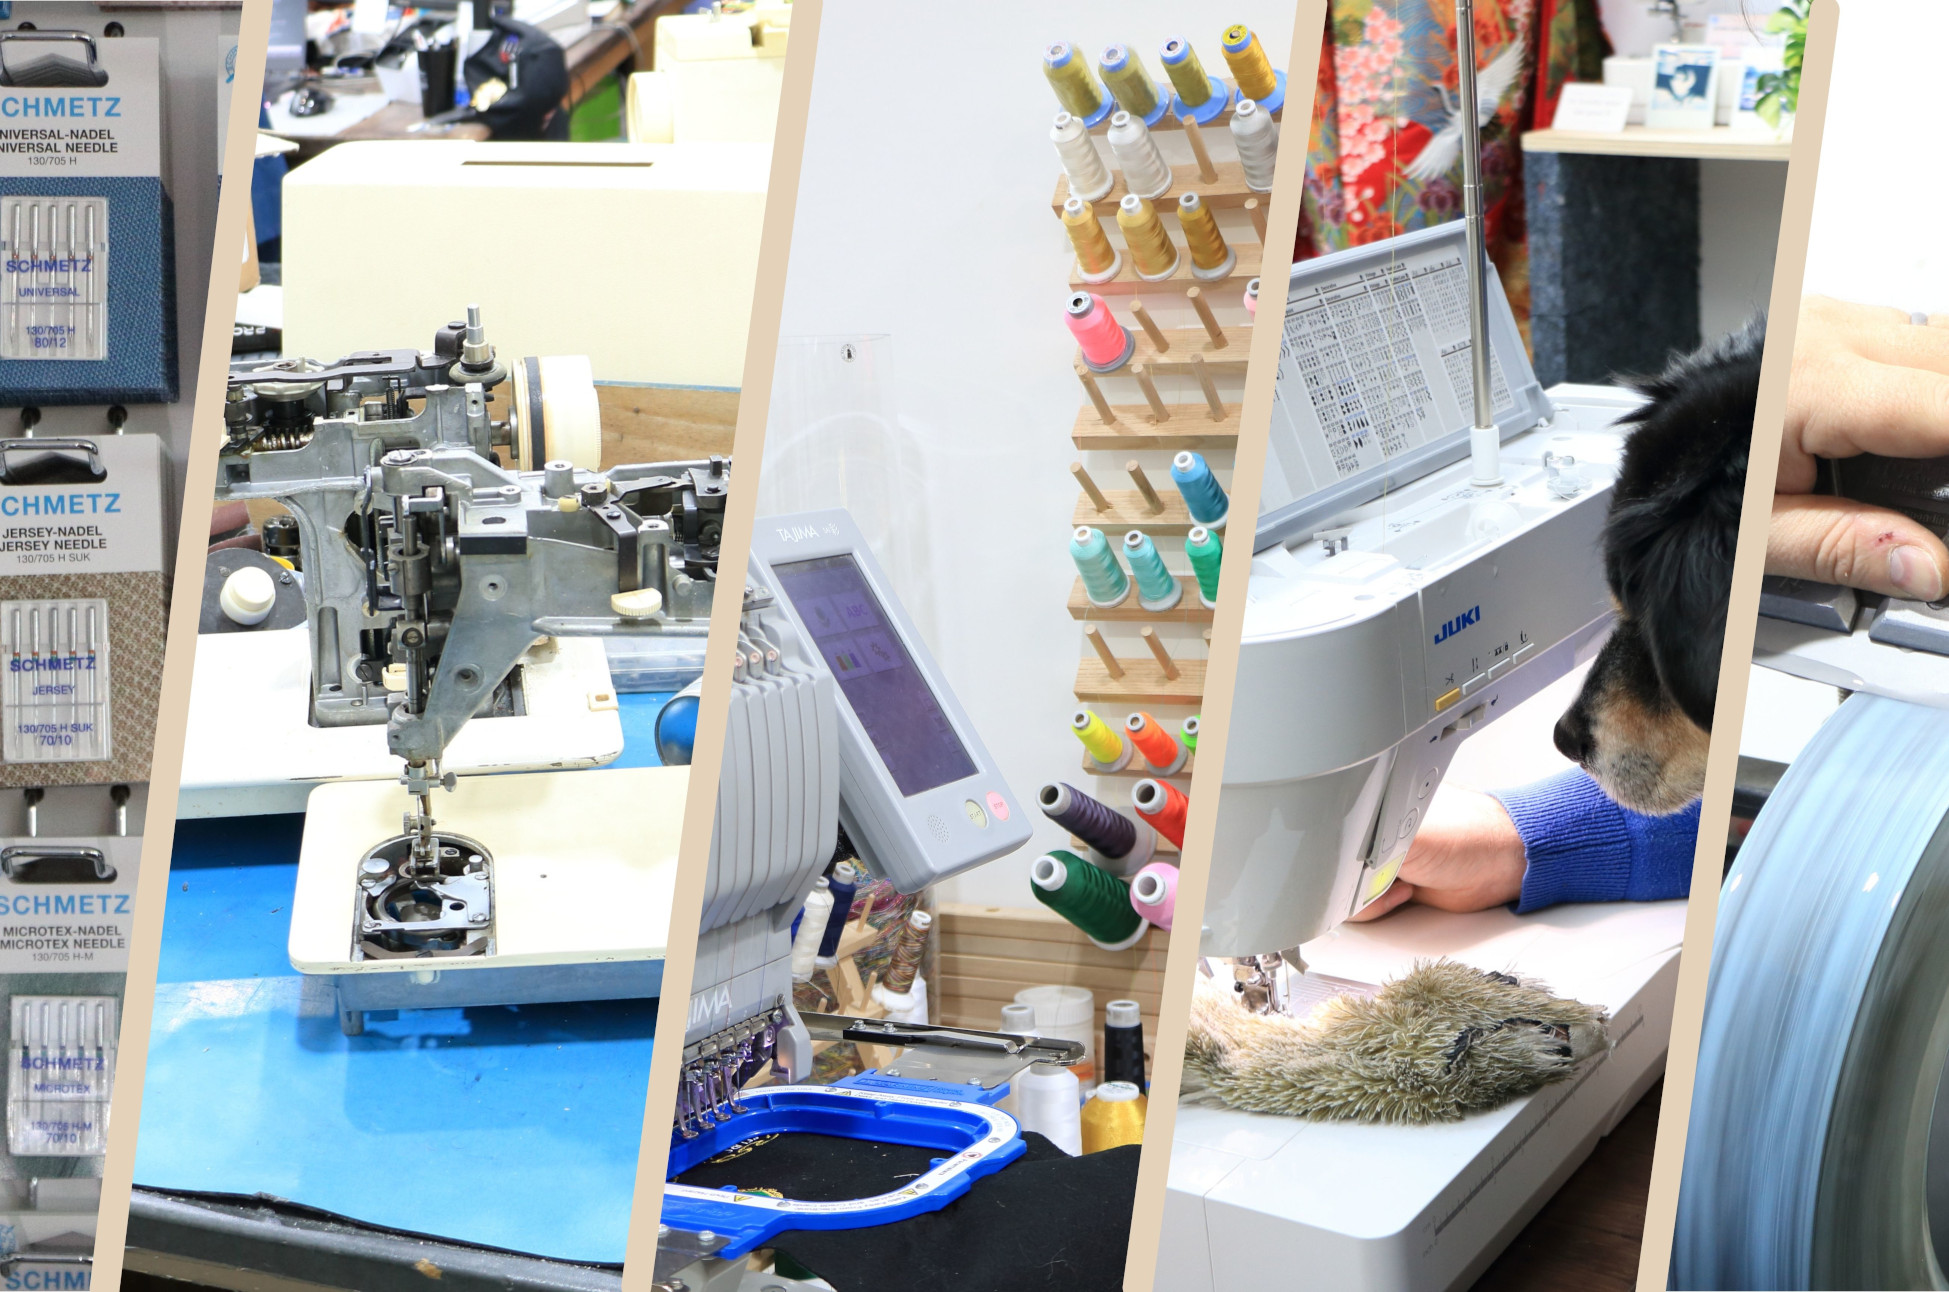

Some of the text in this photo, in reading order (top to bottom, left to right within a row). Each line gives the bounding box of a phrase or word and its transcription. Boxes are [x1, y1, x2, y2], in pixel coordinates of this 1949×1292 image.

[2, 96, 121, 117] CHMETZ
[65, 142, 118, 153] NEEDLE
[28, 156, 77, 166] 130/705 H
[6, 260, 91, 273] SCHMETZ
[19, 287, 80, 297] UNIVERSAL
[26, 325, 76, 335] 130/705 H
[34, 337, 67, 348] 80/12
[1, 493, 121, 516] CHMETZ
[2, 525, 103, 539] JERSEY-NADEL
[777, 524, 819, 542] TAJIMA
[0, 538, 107, 552] JERSEY NEEDLE
[17, 552, 91, 564] 130/705 H SUK
[846, 604, 868, 618] ABC
[1434, 605, 1480, 645] JUKI
[10, 656, 96, 672] SCHMETZ
[32, 685, 75, 695] JERSEY
[18, 723, 93, 734] 130/705 H SUK
[40, 735, 72, 746] 70/10
[3, 925, 122, 937] MICROTEX-NADEL
[0, 938, 126, 950] MICROTEX NEEDLE
[33, 952, 94, 962] 130/705 H-M
[21, 1057, 105, 1070] SCHMETZ
[34, 1083, 91, 1094] MICROTEX
[46, 1133, 77, 1144] 70/10
